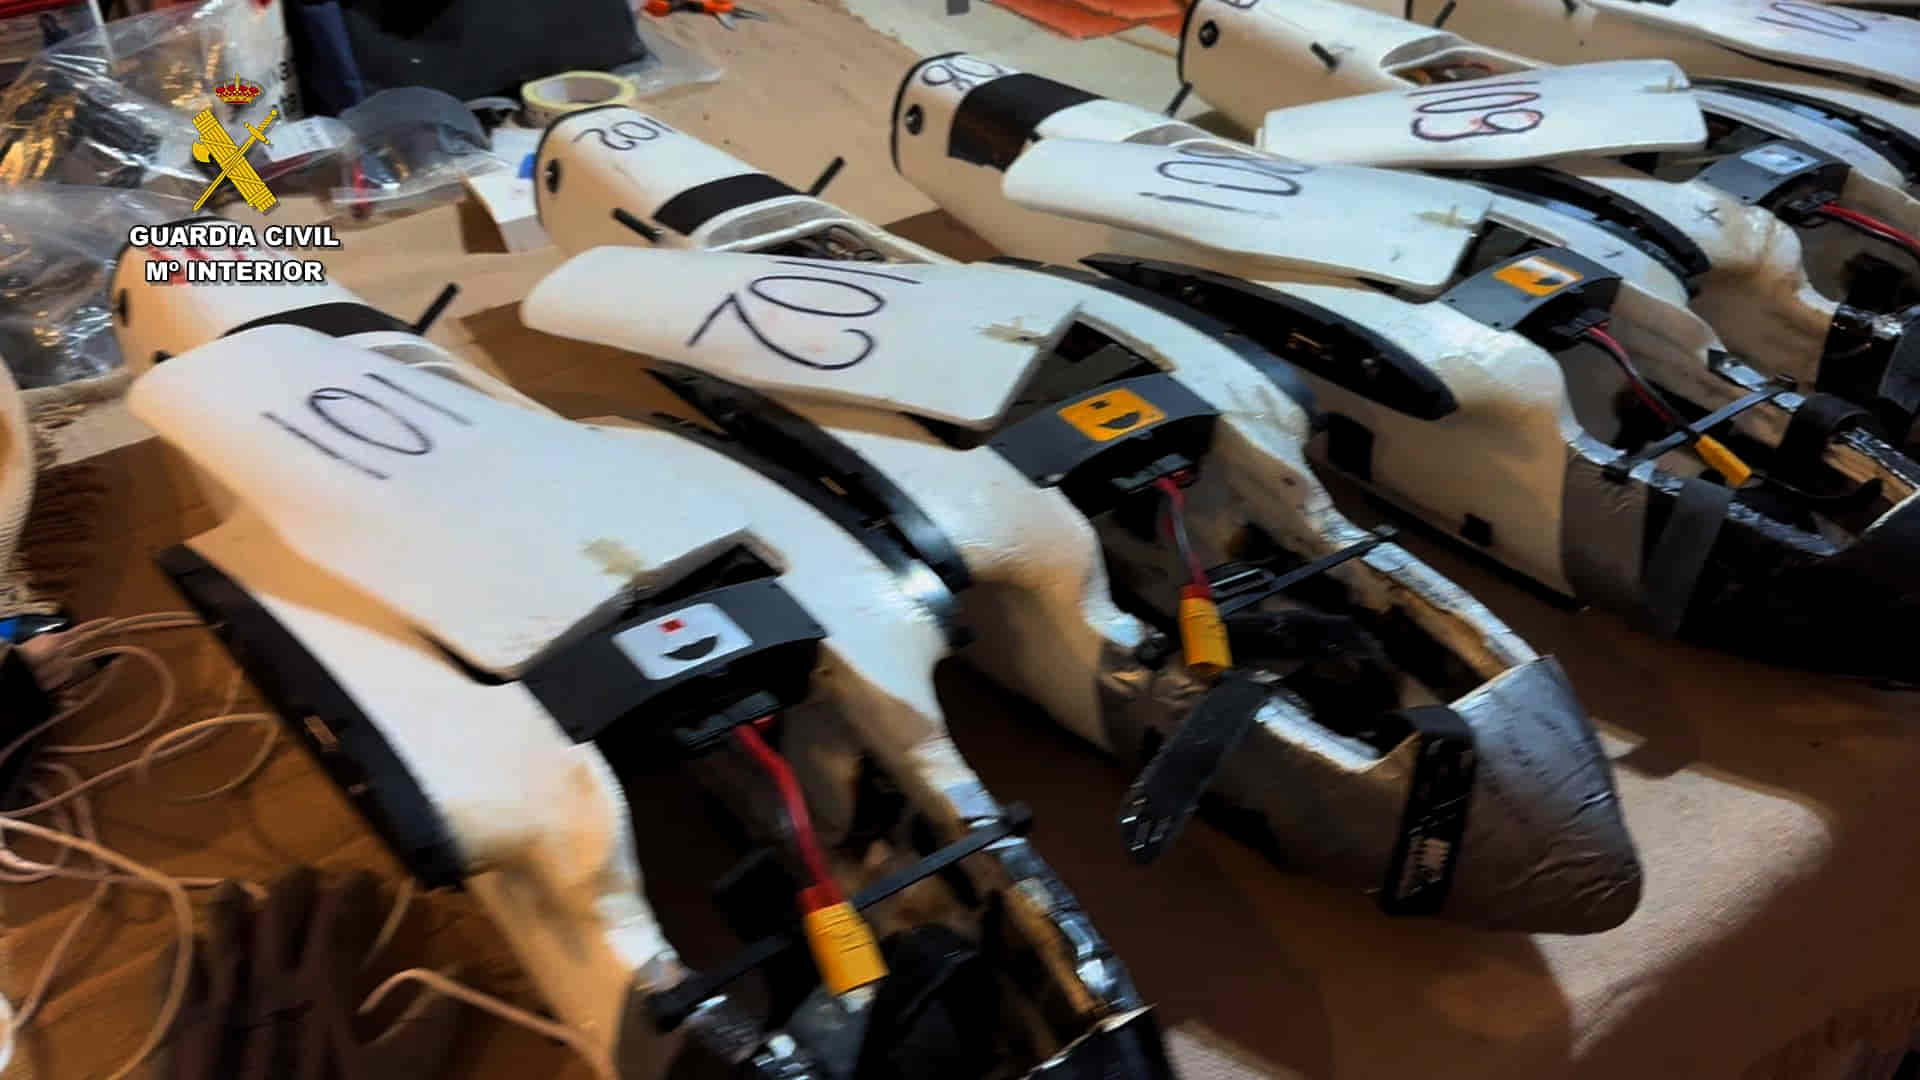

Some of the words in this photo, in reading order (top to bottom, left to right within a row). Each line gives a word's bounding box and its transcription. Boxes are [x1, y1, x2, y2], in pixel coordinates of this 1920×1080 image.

[571, 115, 673, 151] 102
[1405, 80, 1545, 142] 109
[685, 259, 922, 370] 102
[259, 372, 474, 480] 101
